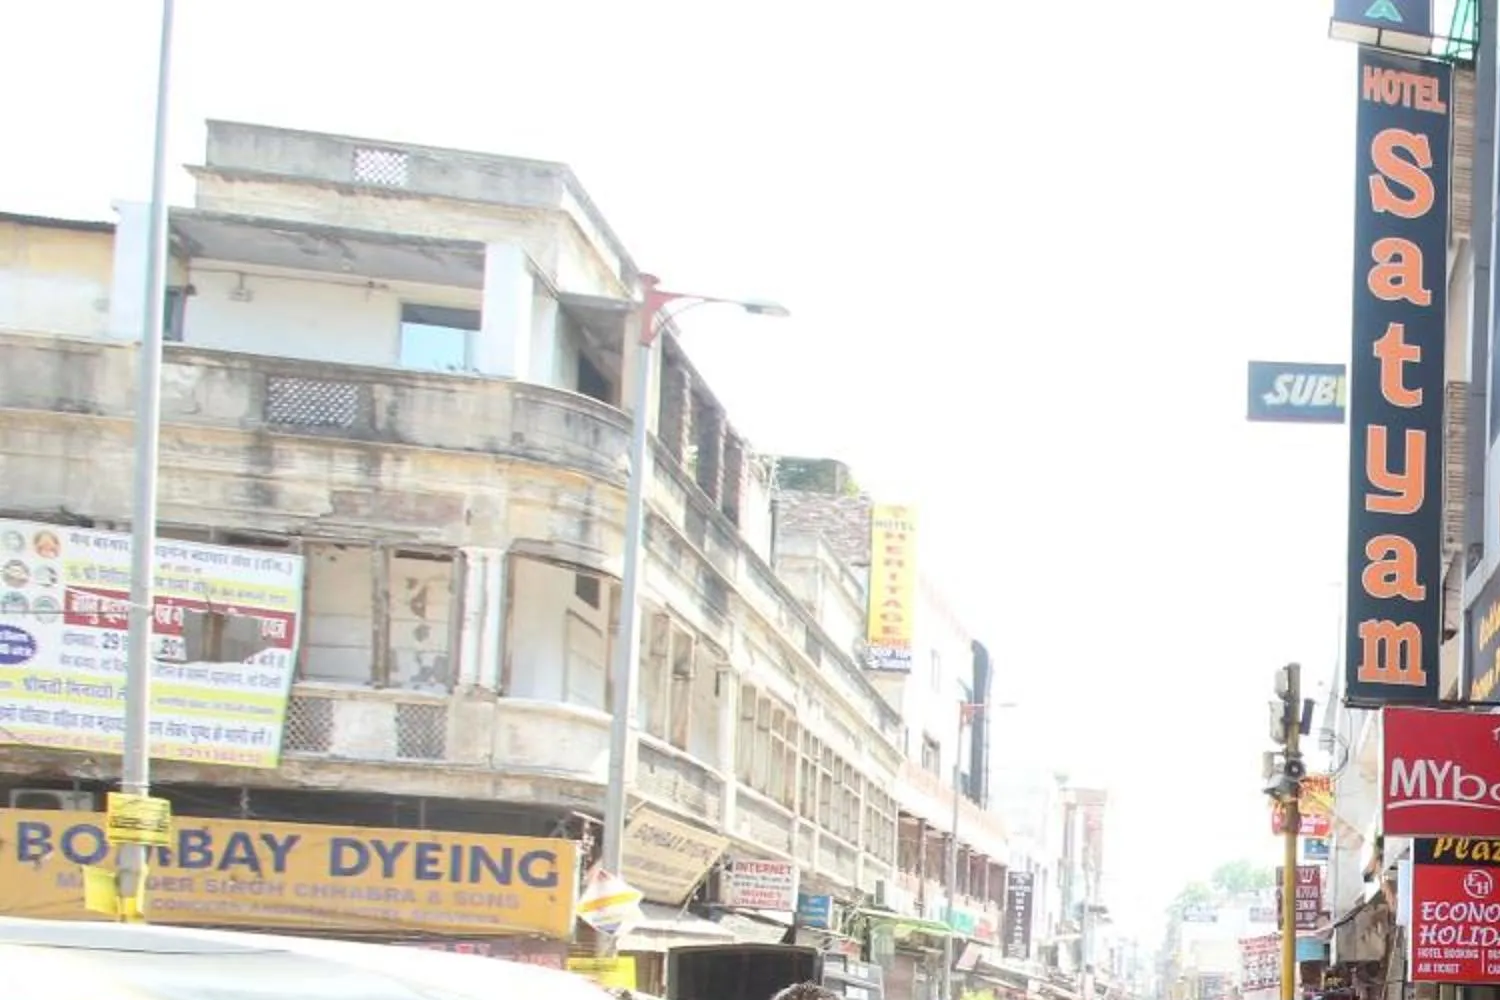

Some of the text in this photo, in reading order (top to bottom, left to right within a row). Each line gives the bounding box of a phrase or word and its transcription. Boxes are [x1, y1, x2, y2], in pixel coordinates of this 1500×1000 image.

[1363, 64, 1446, 114] HOTEL
[1264, 373, 1347, 407] SUB
[1358, 127, 1435, 686] Satyam
[329, 837, 559, 889] DYEING
